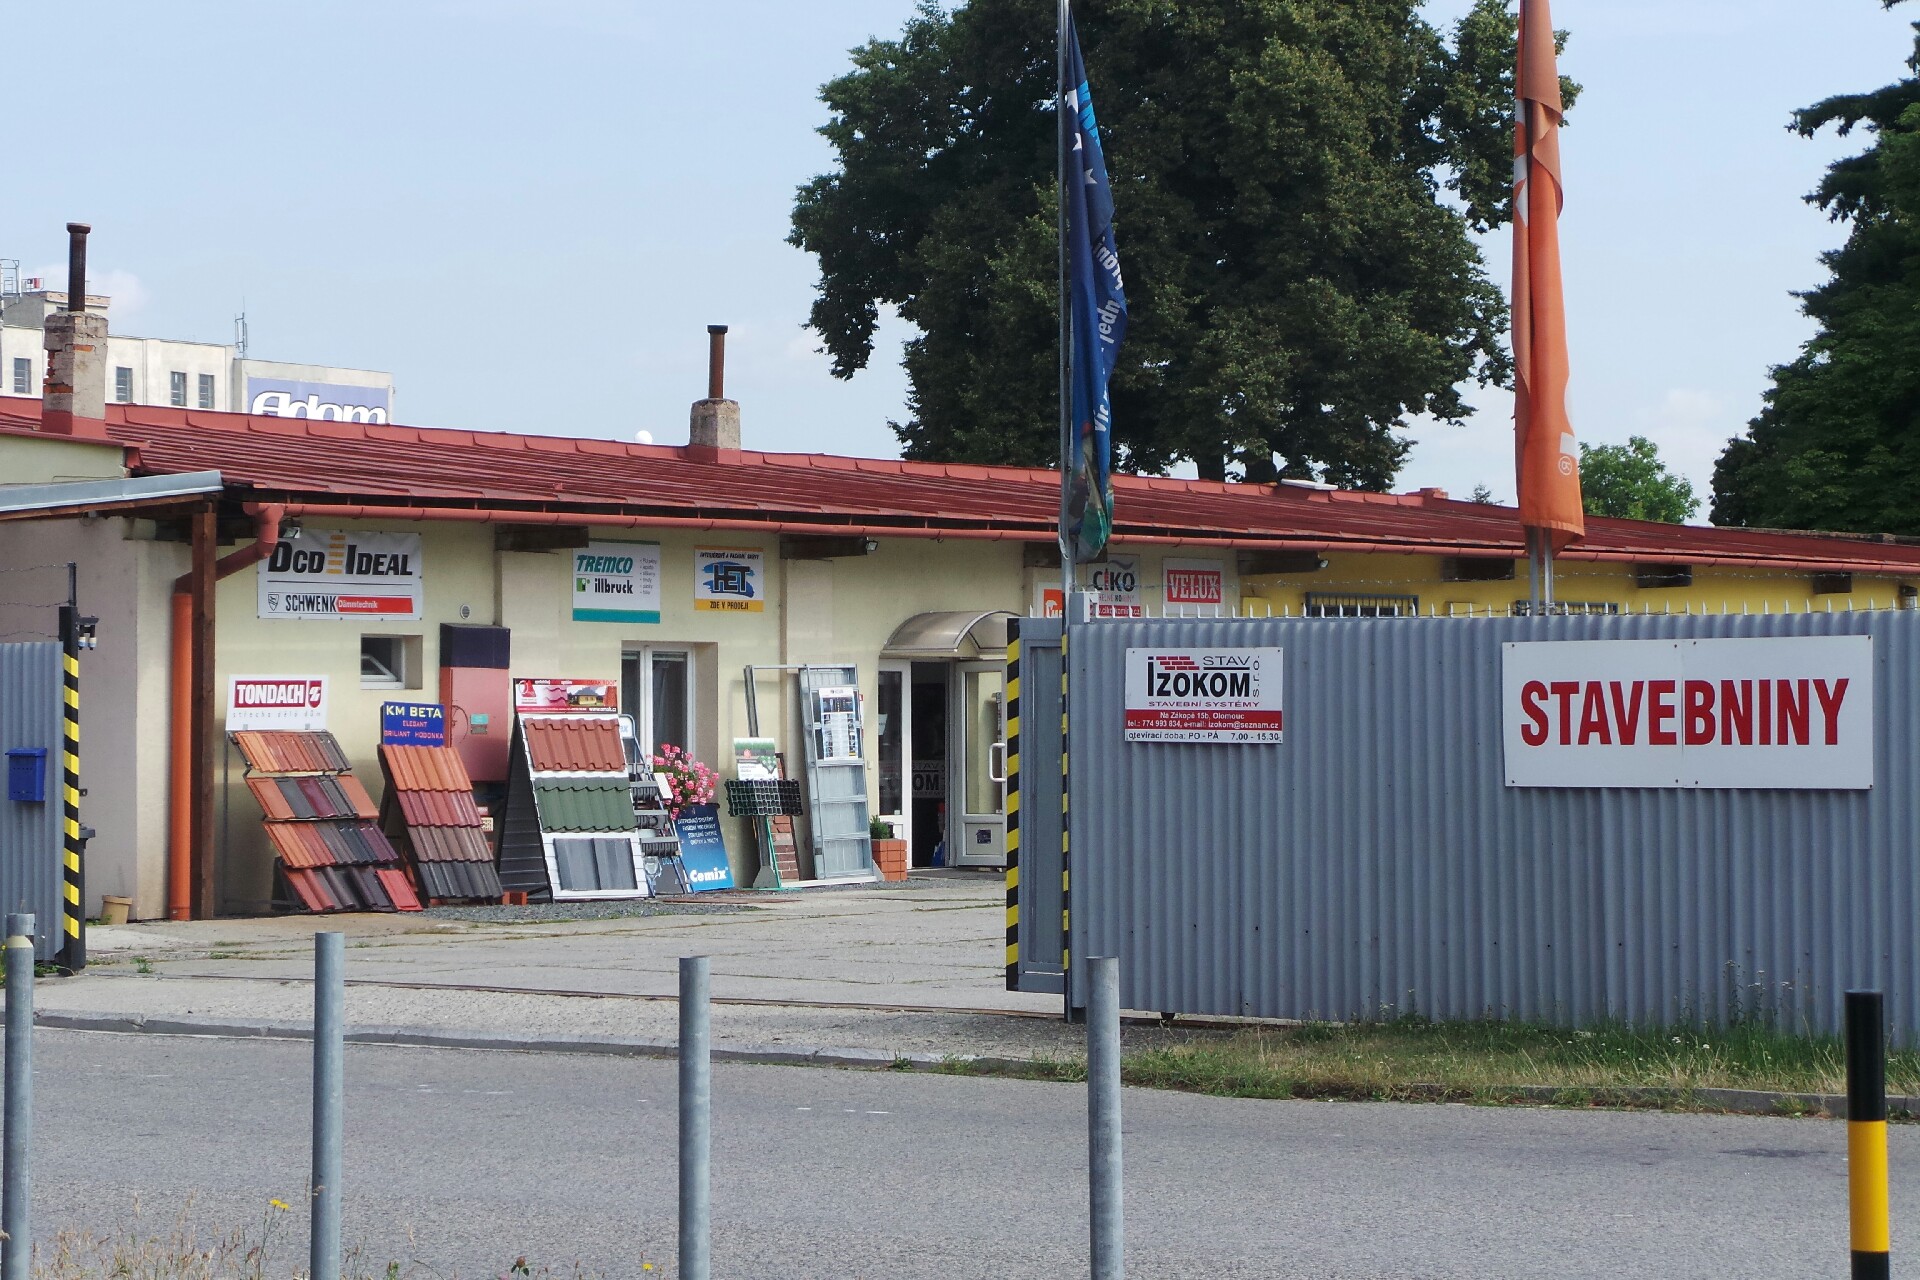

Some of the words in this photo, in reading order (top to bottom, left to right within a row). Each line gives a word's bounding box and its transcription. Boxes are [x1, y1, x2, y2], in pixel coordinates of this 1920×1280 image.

[252, 390, 386, 424] Adom
[268, 542, 325, 574] DCD
[346, 545, 412, 576] IDEAL
[576, 555, 633, 574] TREMCO
[594, 578, 633, 594] illbruck
[713, 564, 750, 592] HET
[1093, 568, 1135, 592] CIKO
[1170, 572, 1219, 600] VELUX
[286, 594, 337, 612] SCHWENK
[728, 602, 748, 610] PRODEJI
[1203, 656, 1250, 666] STAV
[237, 684, 304, 704] TONDACH
[386, 705, 404, 716] KM
[410, 707, 442, 718] BETA
[1520, 678, 1850, 746] STAVEBNINY
[1128, 732, 1162, 740] otevírací
[690, 867, 727, 882] Cemix
